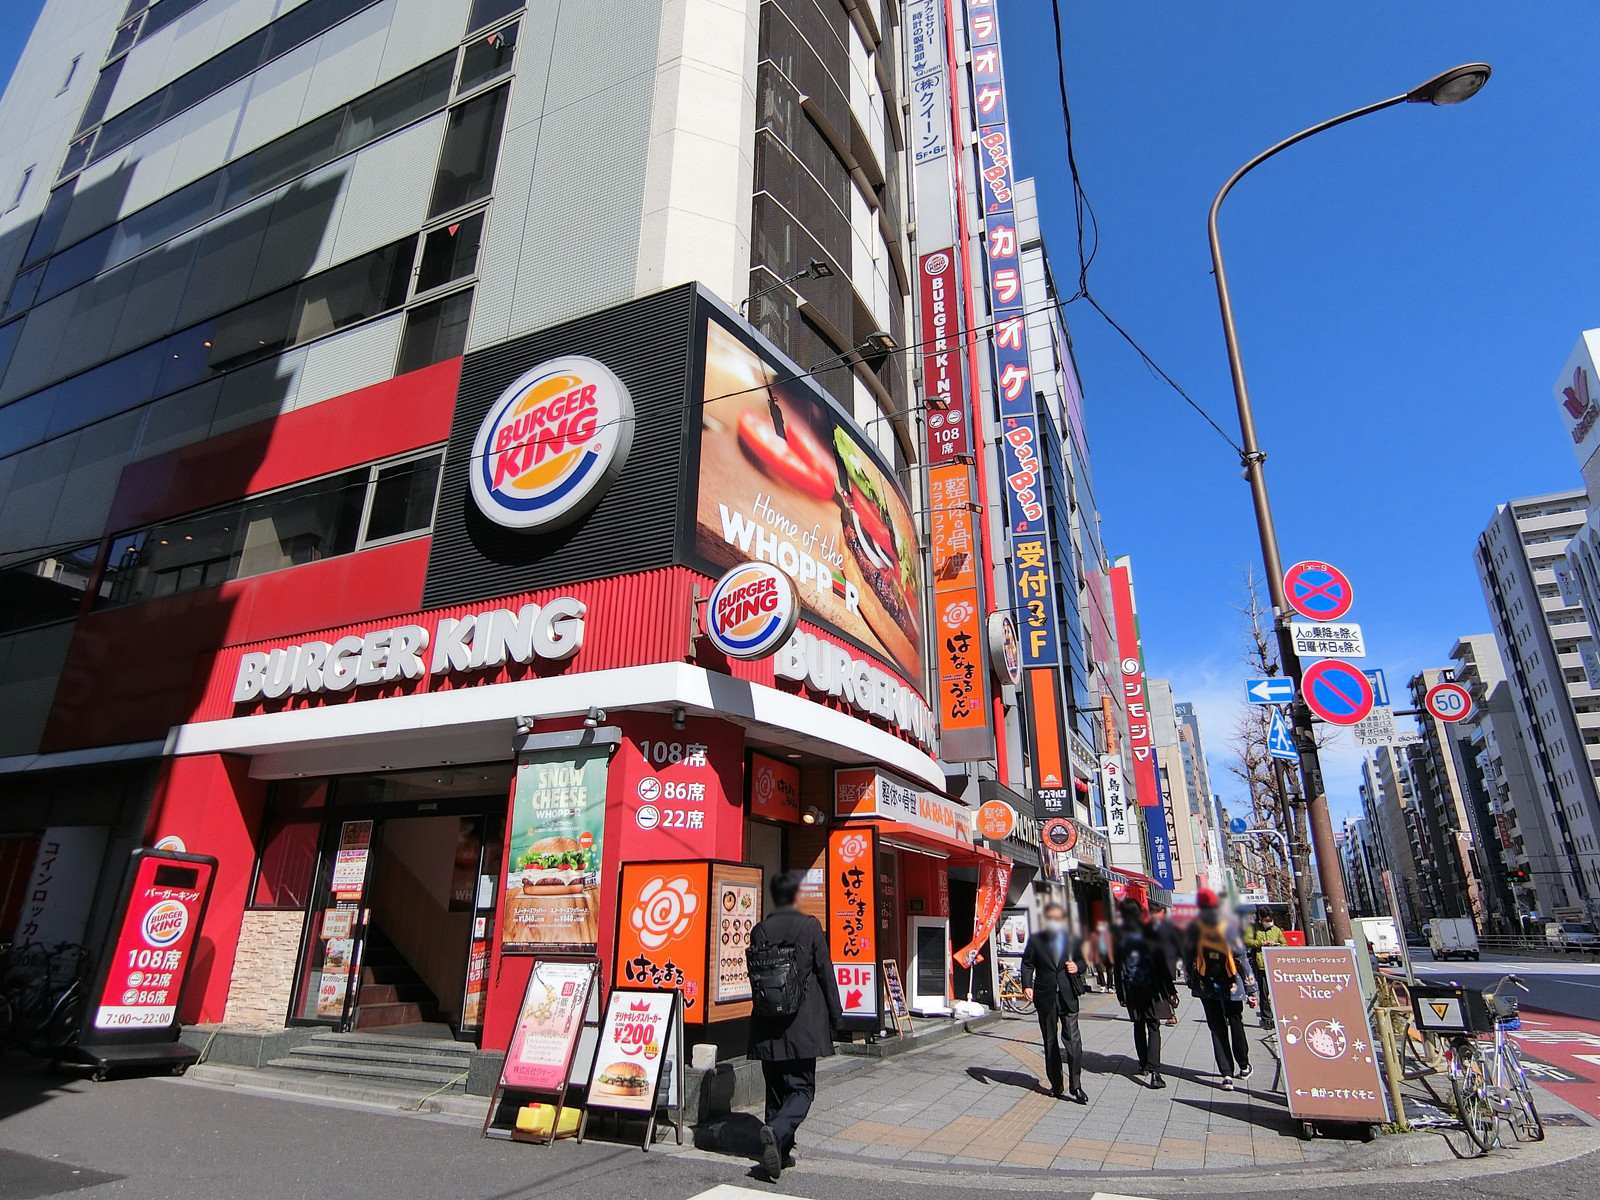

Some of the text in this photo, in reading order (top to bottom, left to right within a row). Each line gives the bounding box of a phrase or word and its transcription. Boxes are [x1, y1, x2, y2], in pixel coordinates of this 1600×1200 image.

[968, 0, 1000, 114] ラオケ
[916, 65, 941, 77] Queen
[990, 226, 1029, 401] カラオケ
[496, 384, 597, 452] BURGER
[934, 428, 960, 444] 108
[492, 407, 599, 490] KING
[941, 442, 954, 455] 席
[752, 492, 844, 571] Home of the
[718, 577, 777, 614] BURGER
[718, 591, 778, 635] KING
[1296, 626, 1359, 640] 人の乗降を除く
[233, 597, 587, 702] BURGER KING
[774, 627, 902, 727] BURGER
[1435, 693, 1462, 711] 50
[1125, 682, 1150, 761] シモジマ
[640, 740, 708, 768] 108席
[538, 766, 586, 789] SNOW
[532, 787, 588, 810] CHEESE
[664, 782, 706, 801] 86席
[839, 781, 874, 803] 整体
[1037, 789, 1067, 799] サンマルク
[1044, 798, 1062, 807] カフェ
[663, 809, 705, 830] 22席
[1154, 836, 1168, 879] みずほ銀行
[144, 888, 200, 902] バーガーキング
[149, 919, 183, 935] KING
[151, 910, 183, 924] BURGER
[128, 949, 183, 970] 108席
[625, 953, 684, 985] はなまる
[142, 972, 173, 988] 22席
[837, 967, 871, 986] B1F
[1273, 969, 1351, 987] Strawberry
[138, 989, 169, 1004] 86席
[1299, 986, 1332, 999] Nice
[614, 1012, 662, 1024] テリヤキレタスバーガー
[613, 1023, 655, 1045] ¥200
[1310, 1088, 1375, 1099] 曲がってすぐそこ
